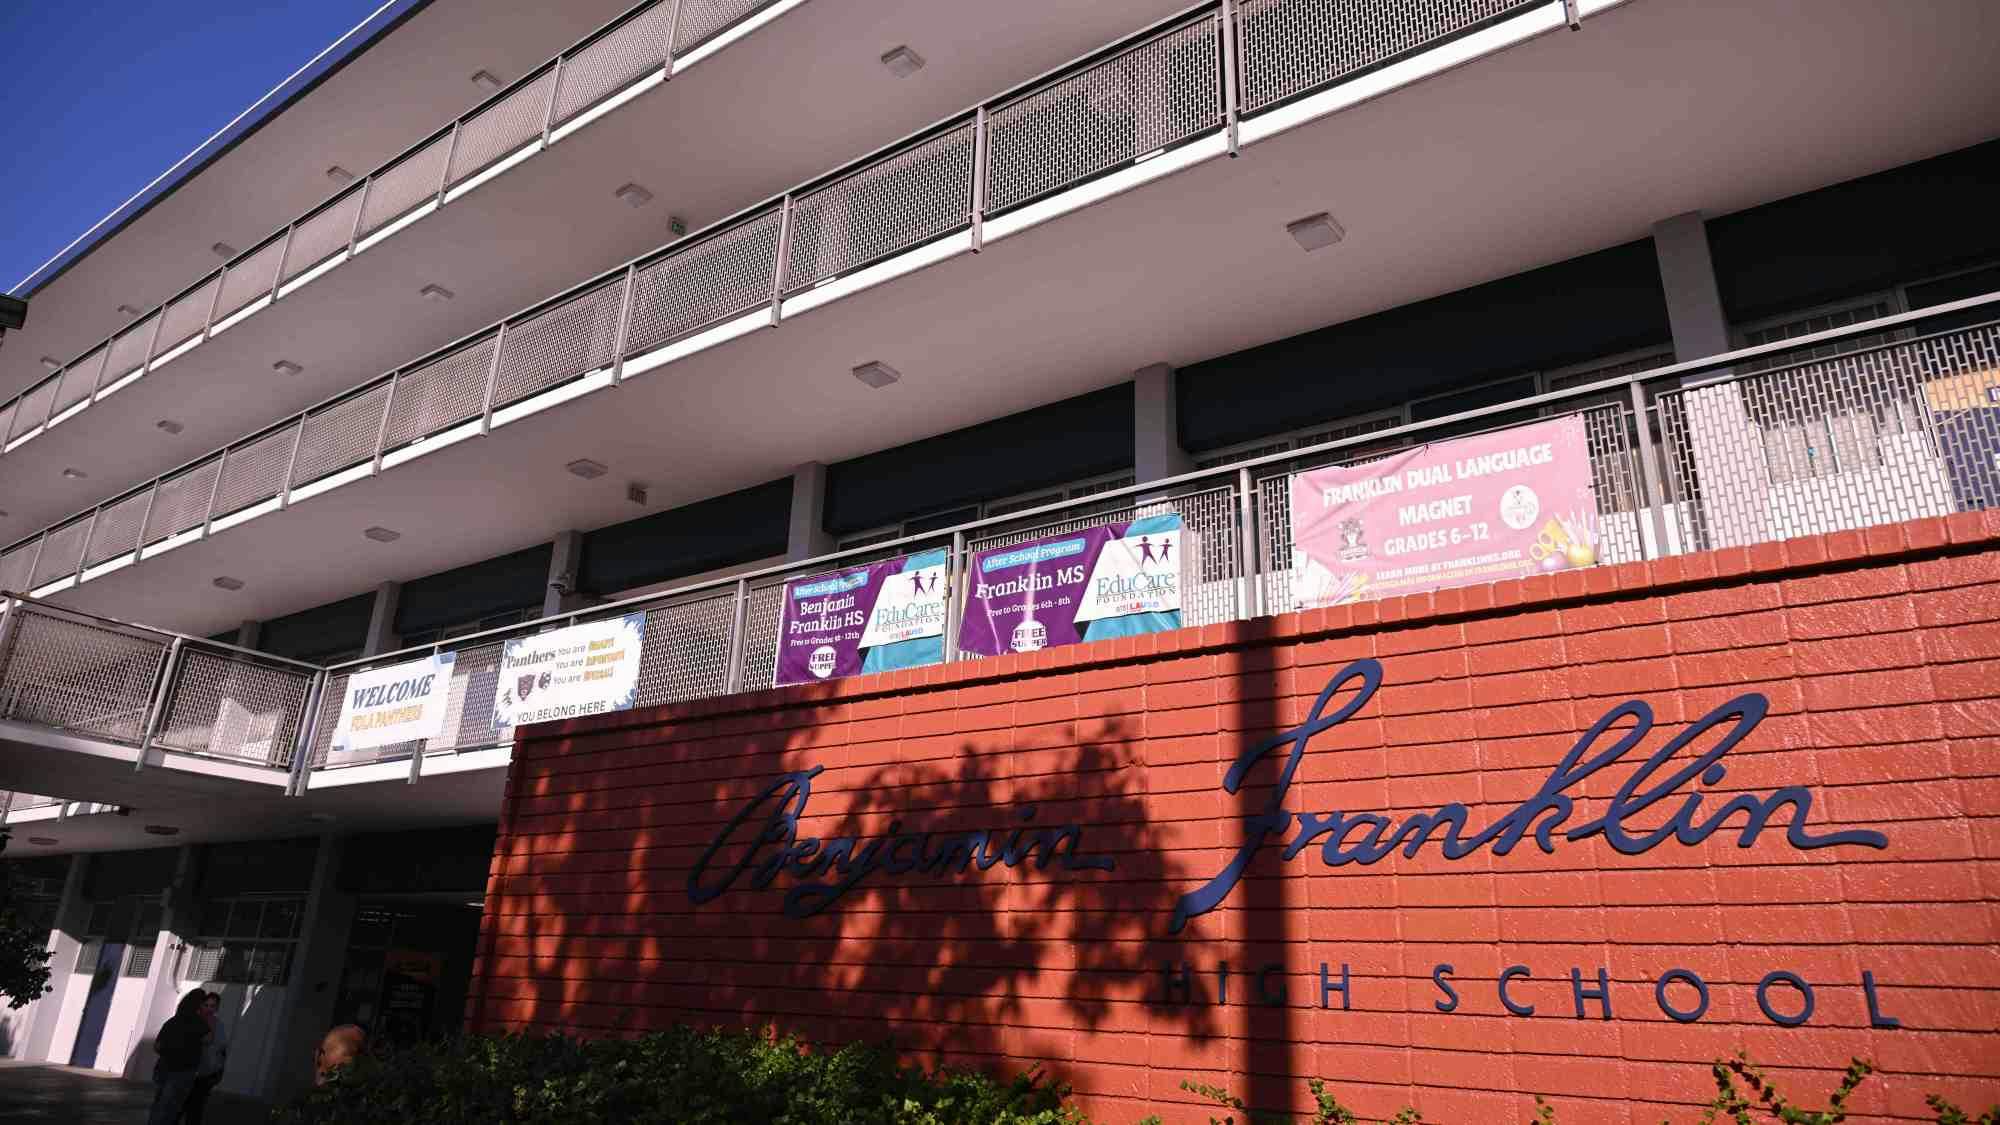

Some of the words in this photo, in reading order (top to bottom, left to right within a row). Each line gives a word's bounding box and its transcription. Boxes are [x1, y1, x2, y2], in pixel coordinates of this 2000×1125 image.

[1323, 474, 1402, 507] FRANKLIN
[1408, 464, 1453, 490] DUAL
[1456, 442, 1553, 477] LANGUAGE
[1399, 496, 1473, 526] MAGNET
[1384, 532, 1448, 556] GRADES
[975, 573, 1053, 600] Franklin
[1057, 565, 1085, 587] MS
[1096, 572, 1175, 596] EduCare
[800, 594, 855, 617] Benjamin
[1012, 601, 1040, 613] Gras
[1096, 587, 1177, 606] FOUNDATION
[789, 615, 842, 634] Franklin
[844, 610, 865, 628] HS
[876, 601, 940, 626] EduCare
[1011, 637, 1048, 649] SUPER
[1014, 627, 1046, 639] FEE
[506, 649, 556, 669] Panthers
[352, 674, 436, 710] WELCOME
[517, 711, 535, 723] YOU
[536, 703, 576, 720] BELONG
[579, 700, 607, 714] HERE
[688, 764, 1114, 920] Benjamin
[1170, 657, 1888, 934] Franklin
[1160, 961, 1352, 1016] HIGH
[1432, 963, 1900, 1030] SCHOOL
